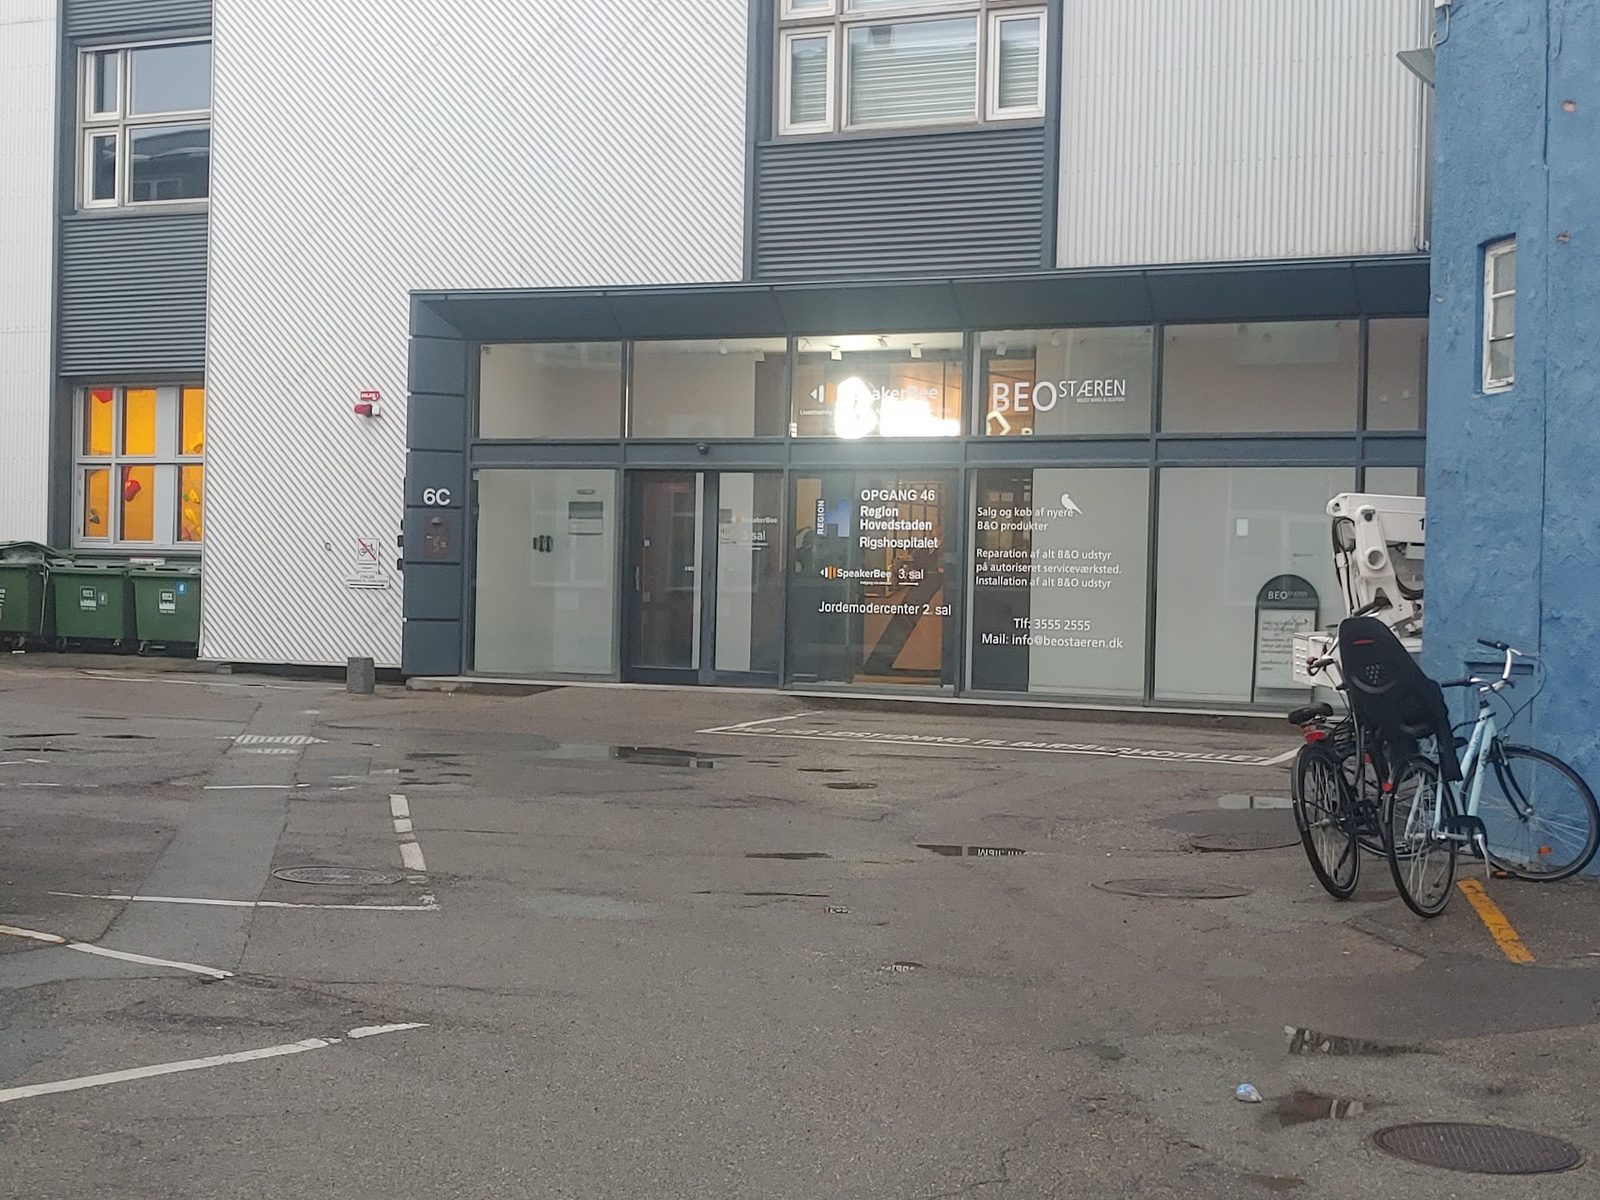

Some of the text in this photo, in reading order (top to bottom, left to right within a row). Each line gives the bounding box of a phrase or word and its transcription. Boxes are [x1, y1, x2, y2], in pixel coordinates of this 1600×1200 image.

[423, 488, 451, 505] 6C
[861, 489, 936, 501] OPGANG 46
[817, 500, 825, 535] REGION
[860, 505, 899, 519] Region
[977, 507, 997, 518] Salg
[999, 509, 1012, 519] og
[1034, 507, 1045, 517] af
[1047, 508, 1074, 519] nyere
[859, 519, 932, 531] Hovedstaden
[977, 521, 1048, 533] B&O produkter
[859, 536, 939, 550] Rigshospitalet
[976, 549, 1112, 562] Reparation af alt B&O udstyr
[837, 568, 892, 580] SpeakerBee
[908, 568, 924, 580] sal
[976, 562, 988, 574] på
[990, 562, 1041, 573] autoriseret
[976, 576, 1112, 590] Installation af alt B&O udstyr
[818, 601, 920, 615] Jordemodercenter
[935, 604, 951, 616] sal
[1013, 618, 1091, 631] Tlf: 3555 2555
[981, 633, 1124, 649] Mail: info@beostaeren.dk
